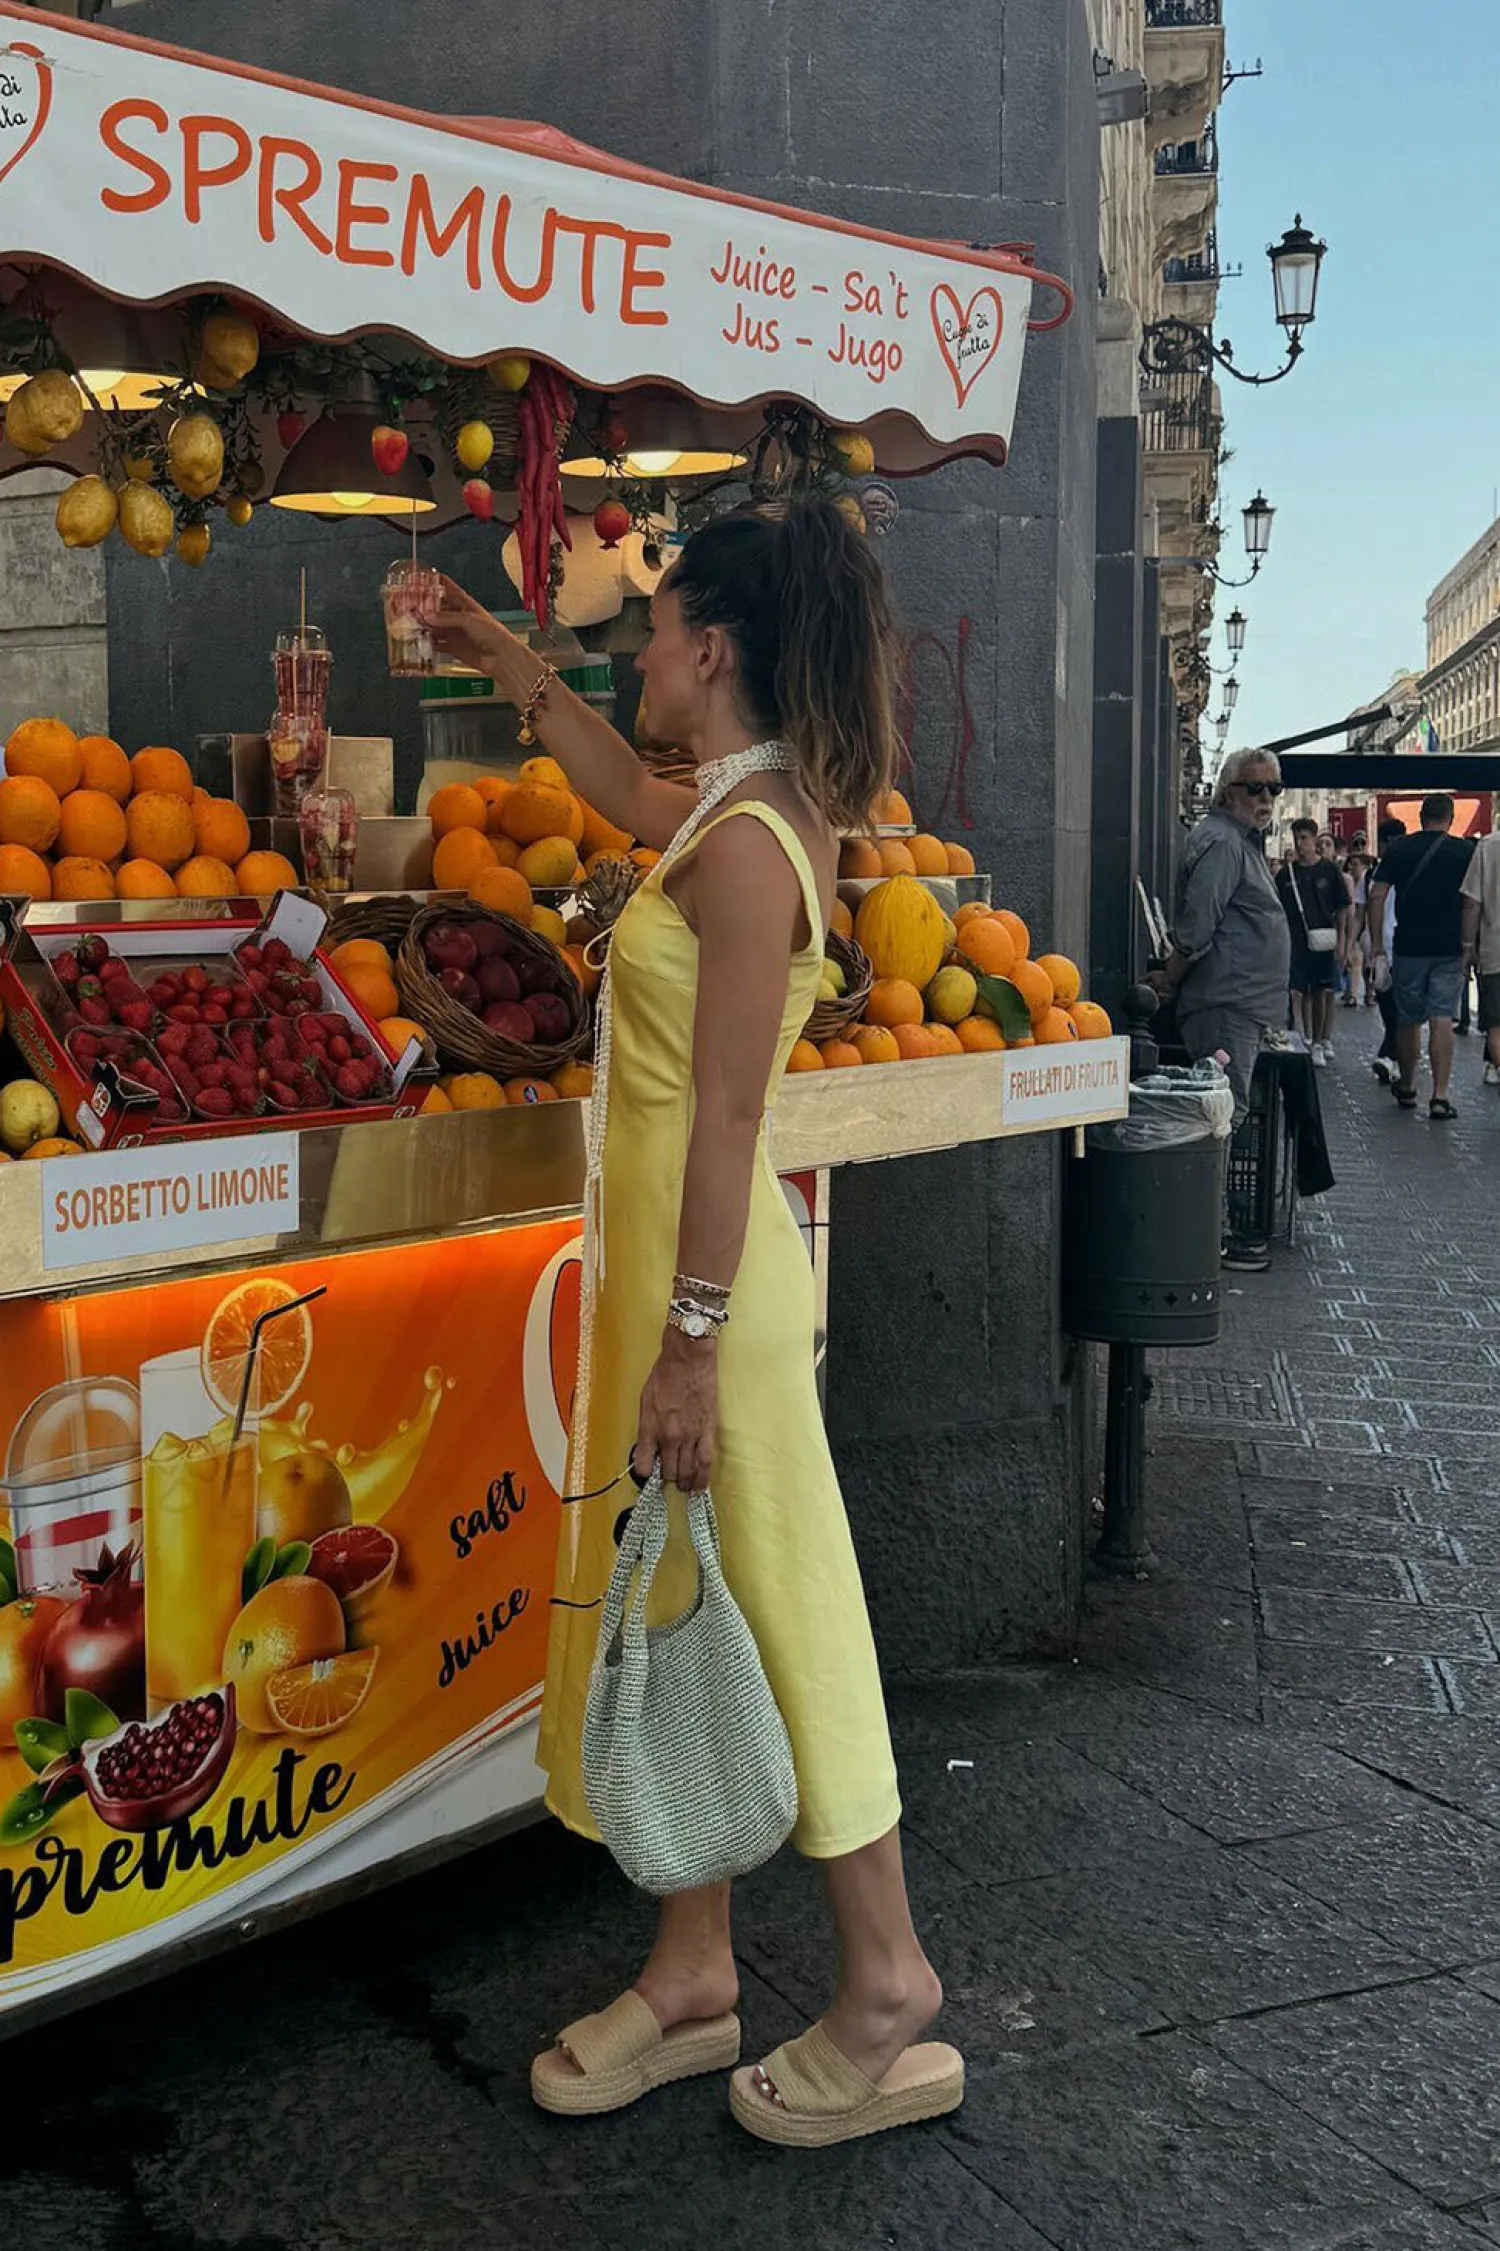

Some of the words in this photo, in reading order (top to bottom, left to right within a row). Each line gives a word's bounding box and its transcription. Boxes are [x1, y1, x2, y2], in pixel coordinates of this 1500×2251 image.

[100, 98, 672, 325] SPREMUTE
[710, 241, 796, 299] Juice
[722, 302, 781, 353] Jus
[827, 323, 902, 384] Jugo
[1009, 1065, 1062, 1100] FRULLATI
[1064, 1063, 1077, 1091] DI
[1078, 1060, 1119, 1090] FRUTTA
[55, 1176, 191, 1233] SORBETTO
[197, 1163, 289, 1211] LIMONE
